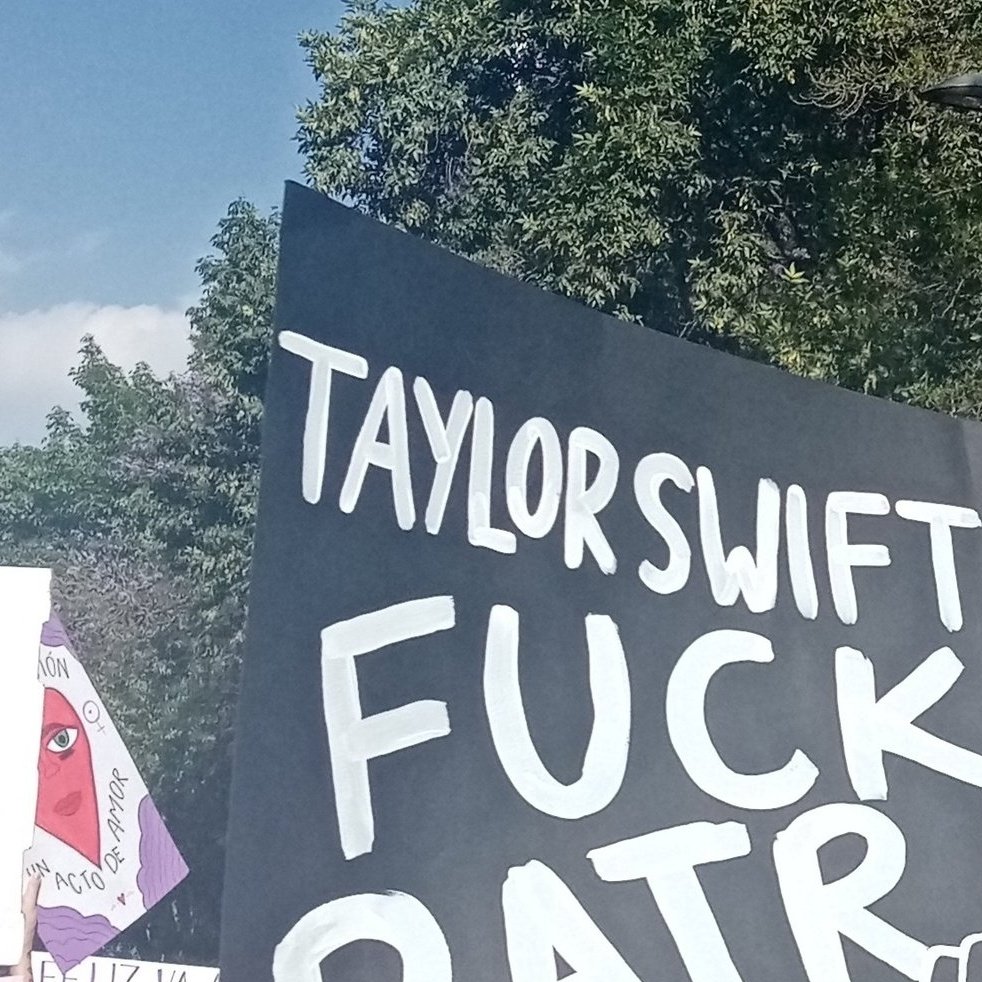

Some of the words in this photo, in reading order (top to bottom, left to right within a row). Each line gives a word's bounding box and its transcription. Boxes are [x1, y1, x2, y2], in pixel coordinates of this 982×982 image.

[279, 330, 620, 575] TAYLOR
[633, 451, 982, 633] SWIFT
[107, 767, 129, 842] AMOR
[55, 869, 106, 895] ACTO
[103, 846, 126, 874] DE
